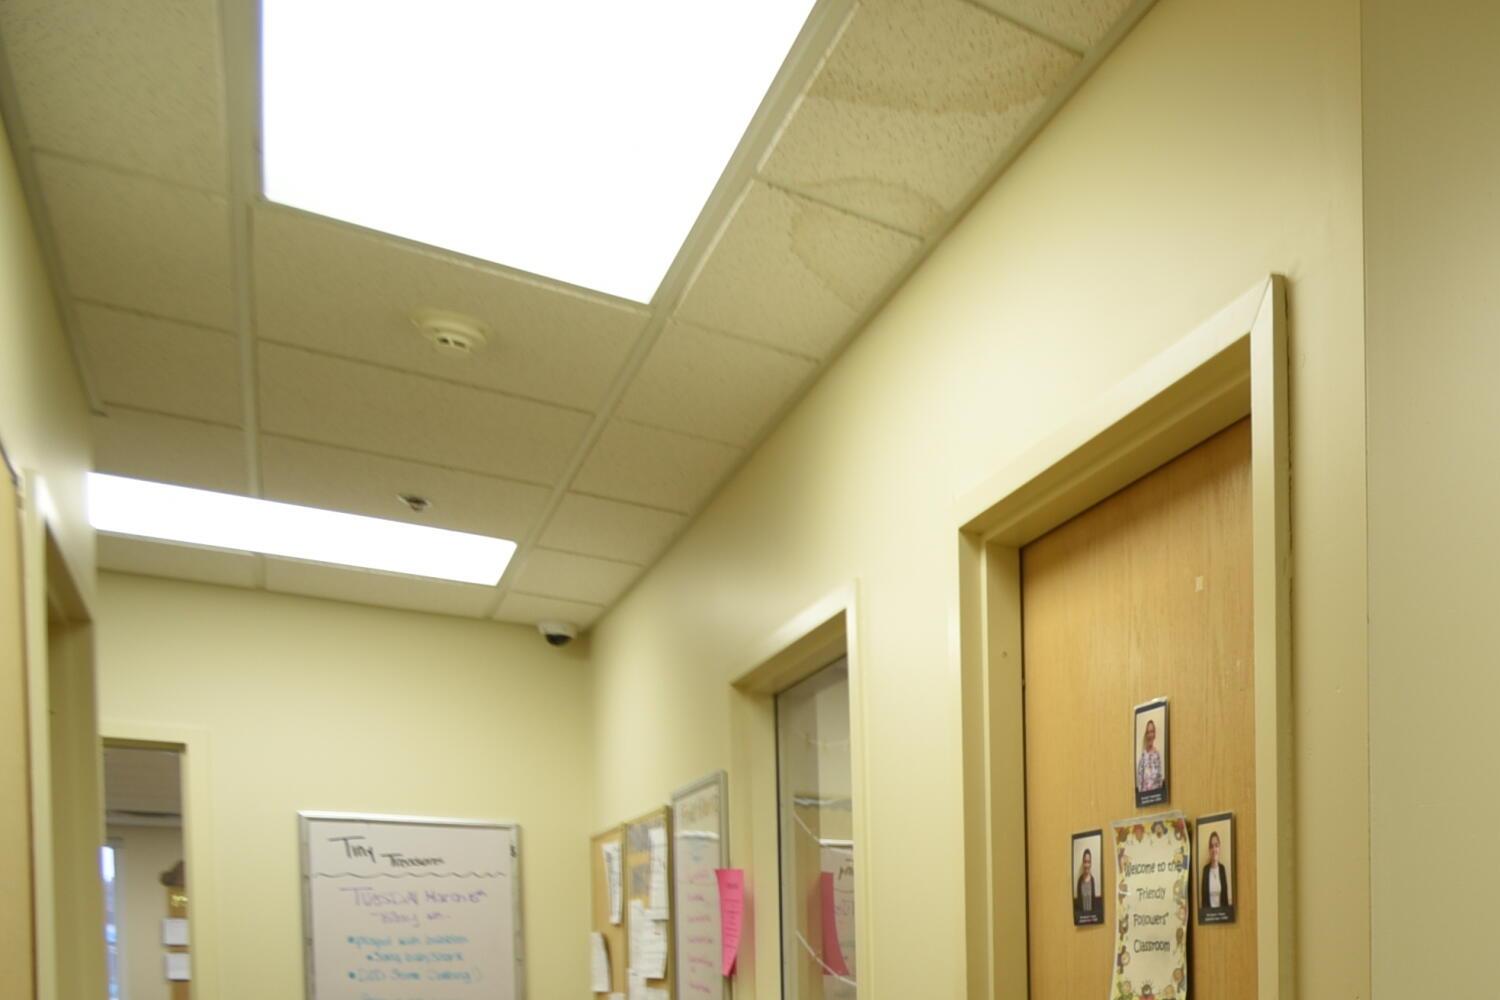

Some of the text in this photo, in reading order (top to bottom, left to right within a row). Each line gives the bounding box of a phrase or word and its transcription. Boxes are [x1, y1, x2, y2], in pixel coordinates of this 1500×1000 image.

[1124, 862, 1155, 877] Welcome
[1156, 862, 1166, 873] to
[1133, 939, 1171, 953] Classroom
